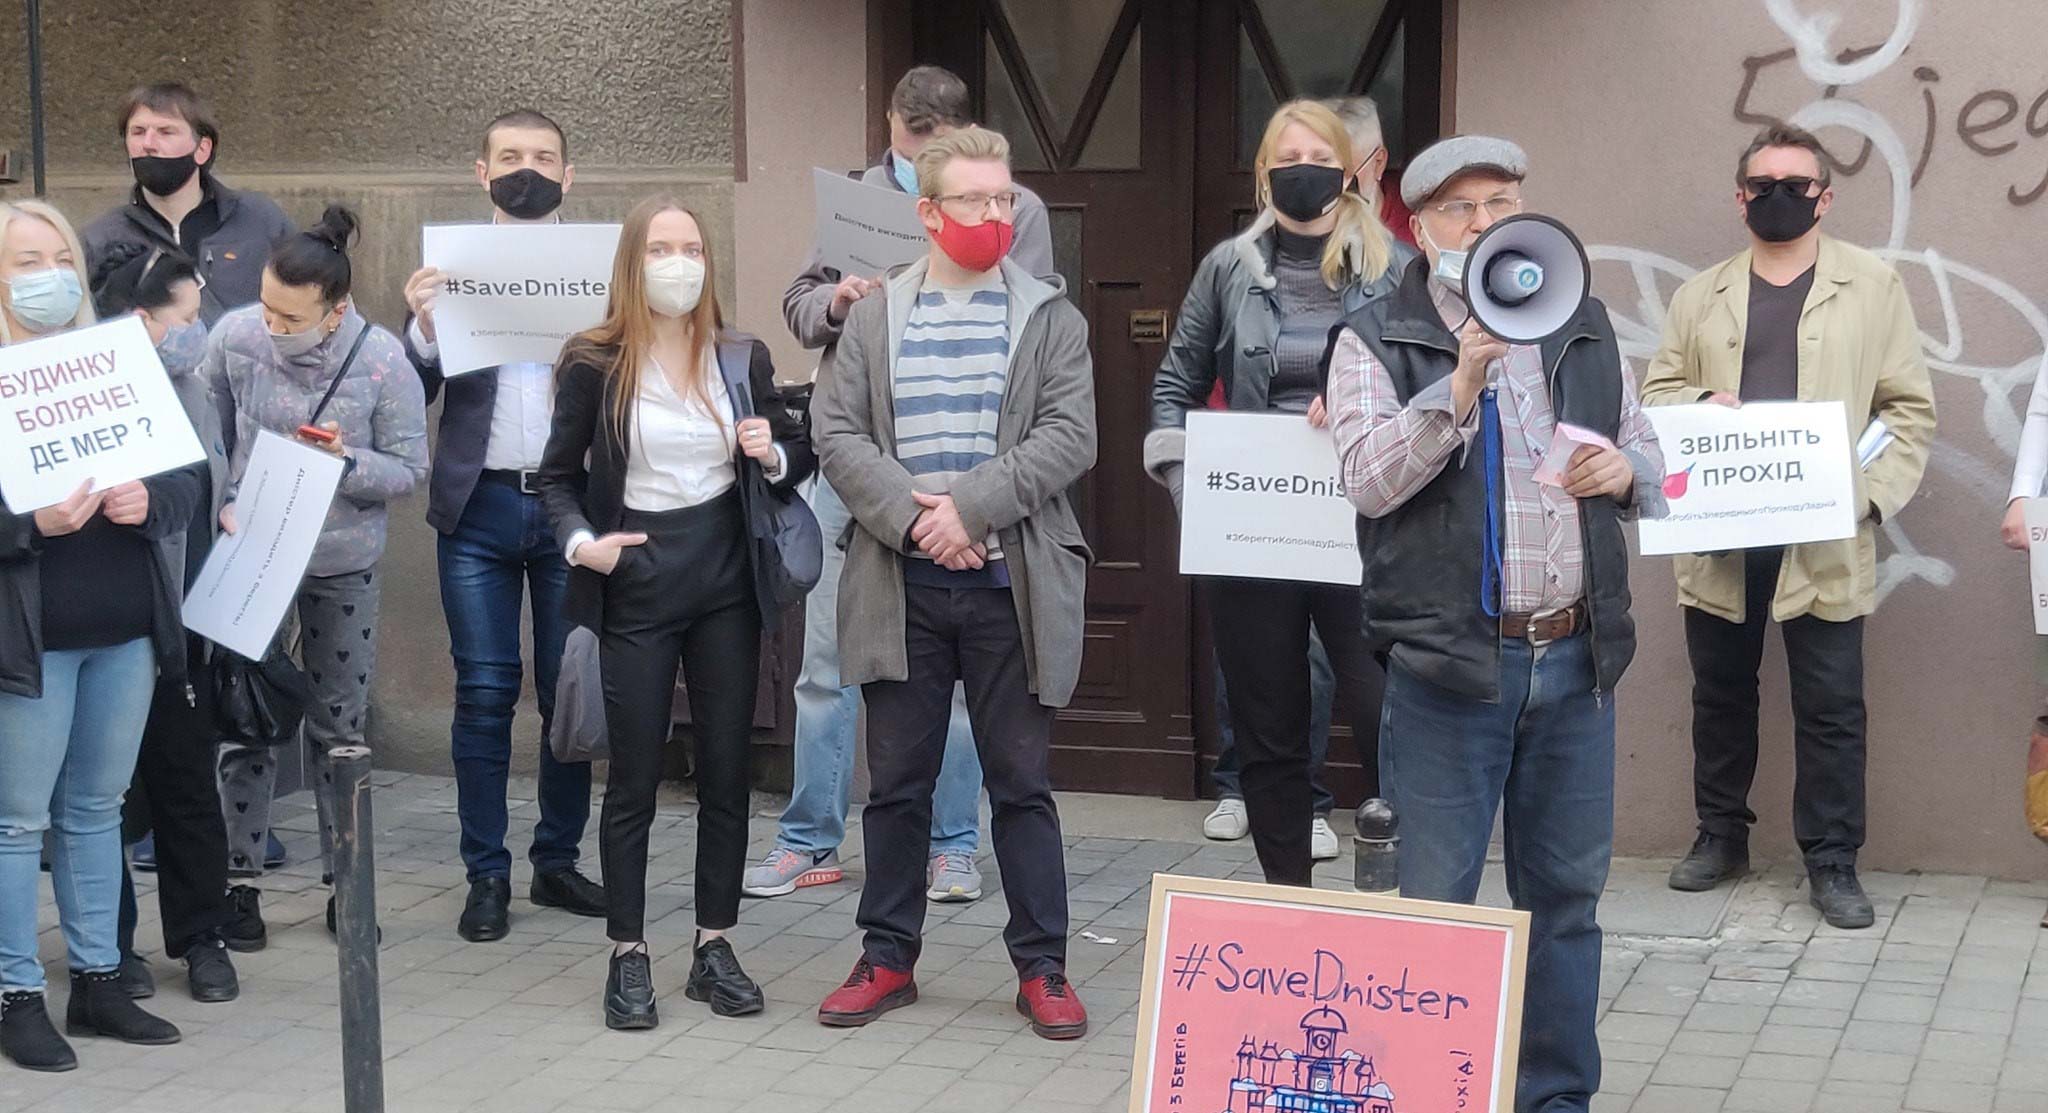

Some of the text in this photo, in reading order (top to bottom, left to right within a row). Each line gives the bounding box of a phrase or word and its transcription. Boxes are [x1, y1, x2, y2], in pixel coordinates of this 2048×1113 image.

[445, 277, 611, 297] #SaveDniste
[0, 349, 116, 399] БУДИНКУ
[15, 383, 140, 433] БОЛЯЧЕ!
[30, 440, 69, 474] ДЕ
[70, 423, 129, 458] МЕР
[1679, 429, 1821, 456] ЗВІЛЬНІТЬ
[1702, 460, 1804, 487] ПРОХІД
[1173, 942, 1469, 1019] #SaveDnister
